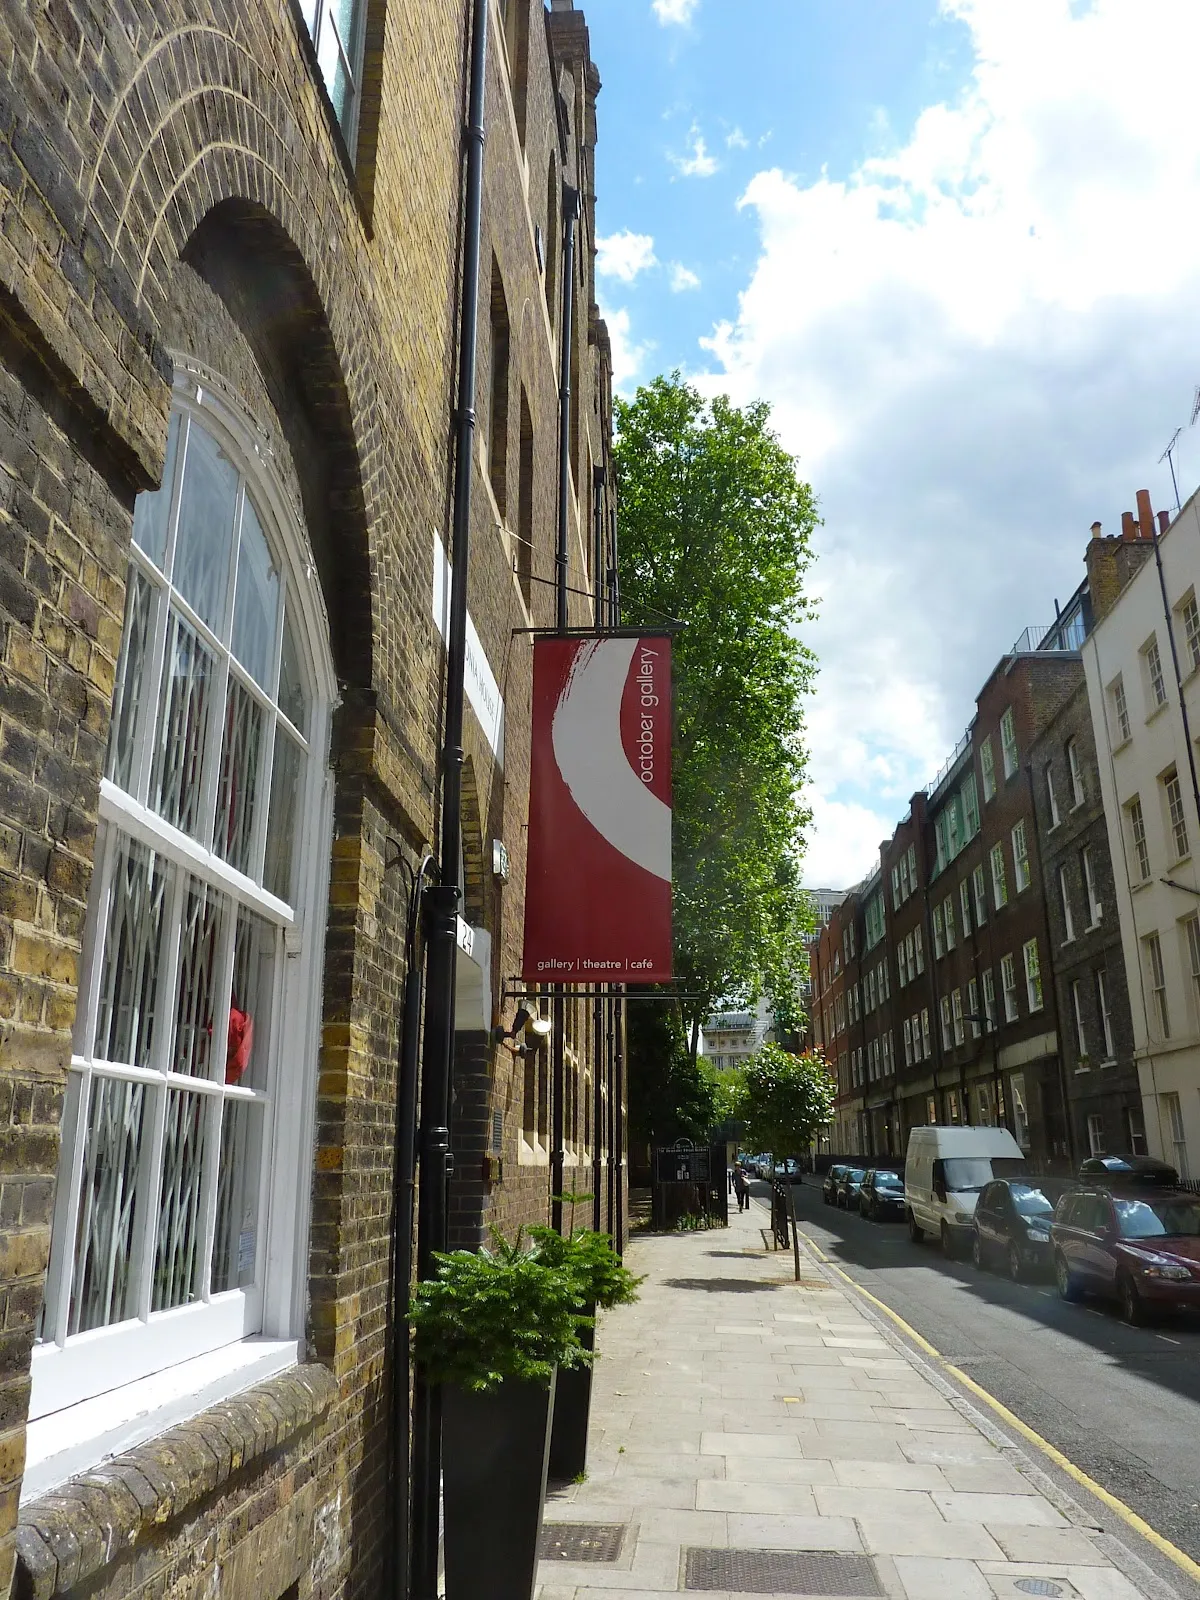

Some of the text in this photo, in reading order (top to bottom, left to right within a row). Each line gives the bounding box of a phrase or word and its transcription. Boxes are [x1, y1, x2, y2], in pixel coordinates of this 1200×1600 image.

[636, 647, 659, 783] october gallery
[462, 924, 472, 955] 24
[537, 958, 653, 971] gallery theatre café
